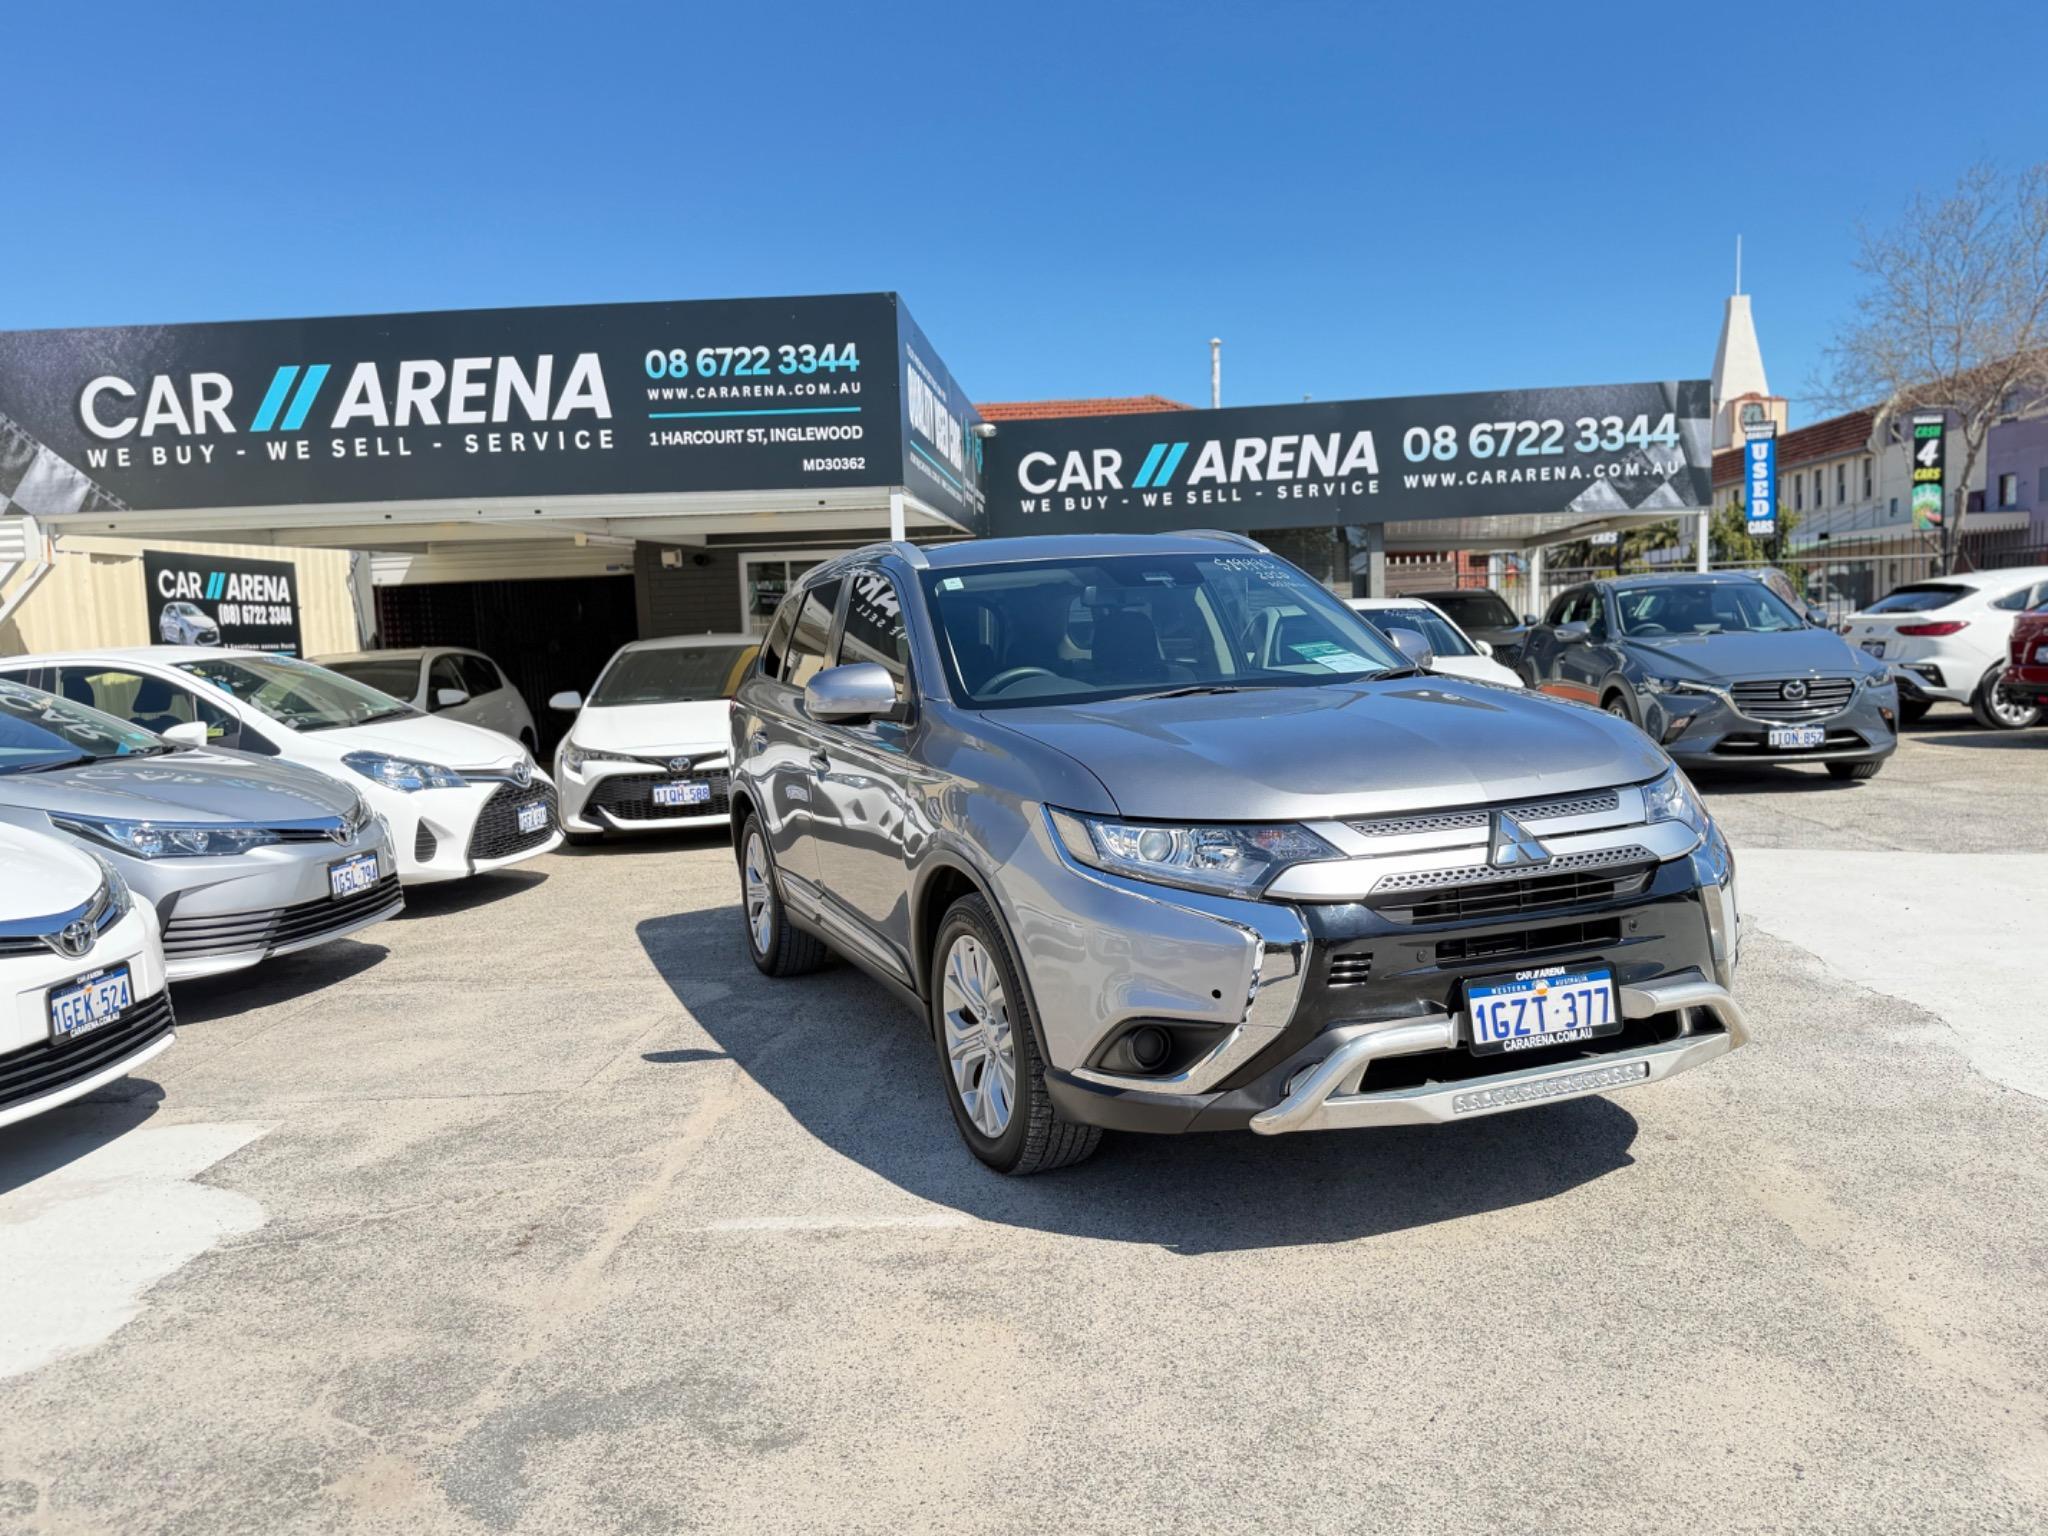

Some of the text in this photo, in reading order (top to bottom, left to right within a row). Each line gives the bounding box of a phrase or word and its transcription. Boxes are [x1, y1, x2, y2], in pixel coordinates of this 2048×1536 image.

[646, 342, 860, 379] 08 6722 3344
[80, 353, 612, 440] CAR ARENA
[646, 382, 862, 402] WWW.CARARENA.COM.AU
[86, 447, 131, 469] WE
[152, 443, 216, 466] BUY
[266, 439, 311, 461] WE
[331, 437, 412, 458] SELL
[464, 429, 614, 454] SERVICE
[649, 424, 863, 446] 1 HARCOURT ST, INGLEWOOD
[1403, 413, 1681, 463] 08 6722 3344
[802, 456, 866, 471] MD30362
[1017, 448, 1124, 494] CAR
[1187, 431, 1380, 486] ARENA
[1916, 439, 1939, 467] 4
[1403, 460, 1681, 489] WWW.CARARENA.COM.AU
[1751, 442, 1770, 518] USED
[1020, 498, 1051, 513] WE
[1064, 495, 1108, 510] BUY
[1142, 491, 1173, 507] WE
[1186, 488, 1242, 504] SELL
[1276, 479, 1380, 500] SERVICE
[157, 569, 291, 603] CAR ARENA
[1491, 984, 1527, 995] WESTERN
[1503, 1028, 1593, 1052] CARARENA.COM.AU
